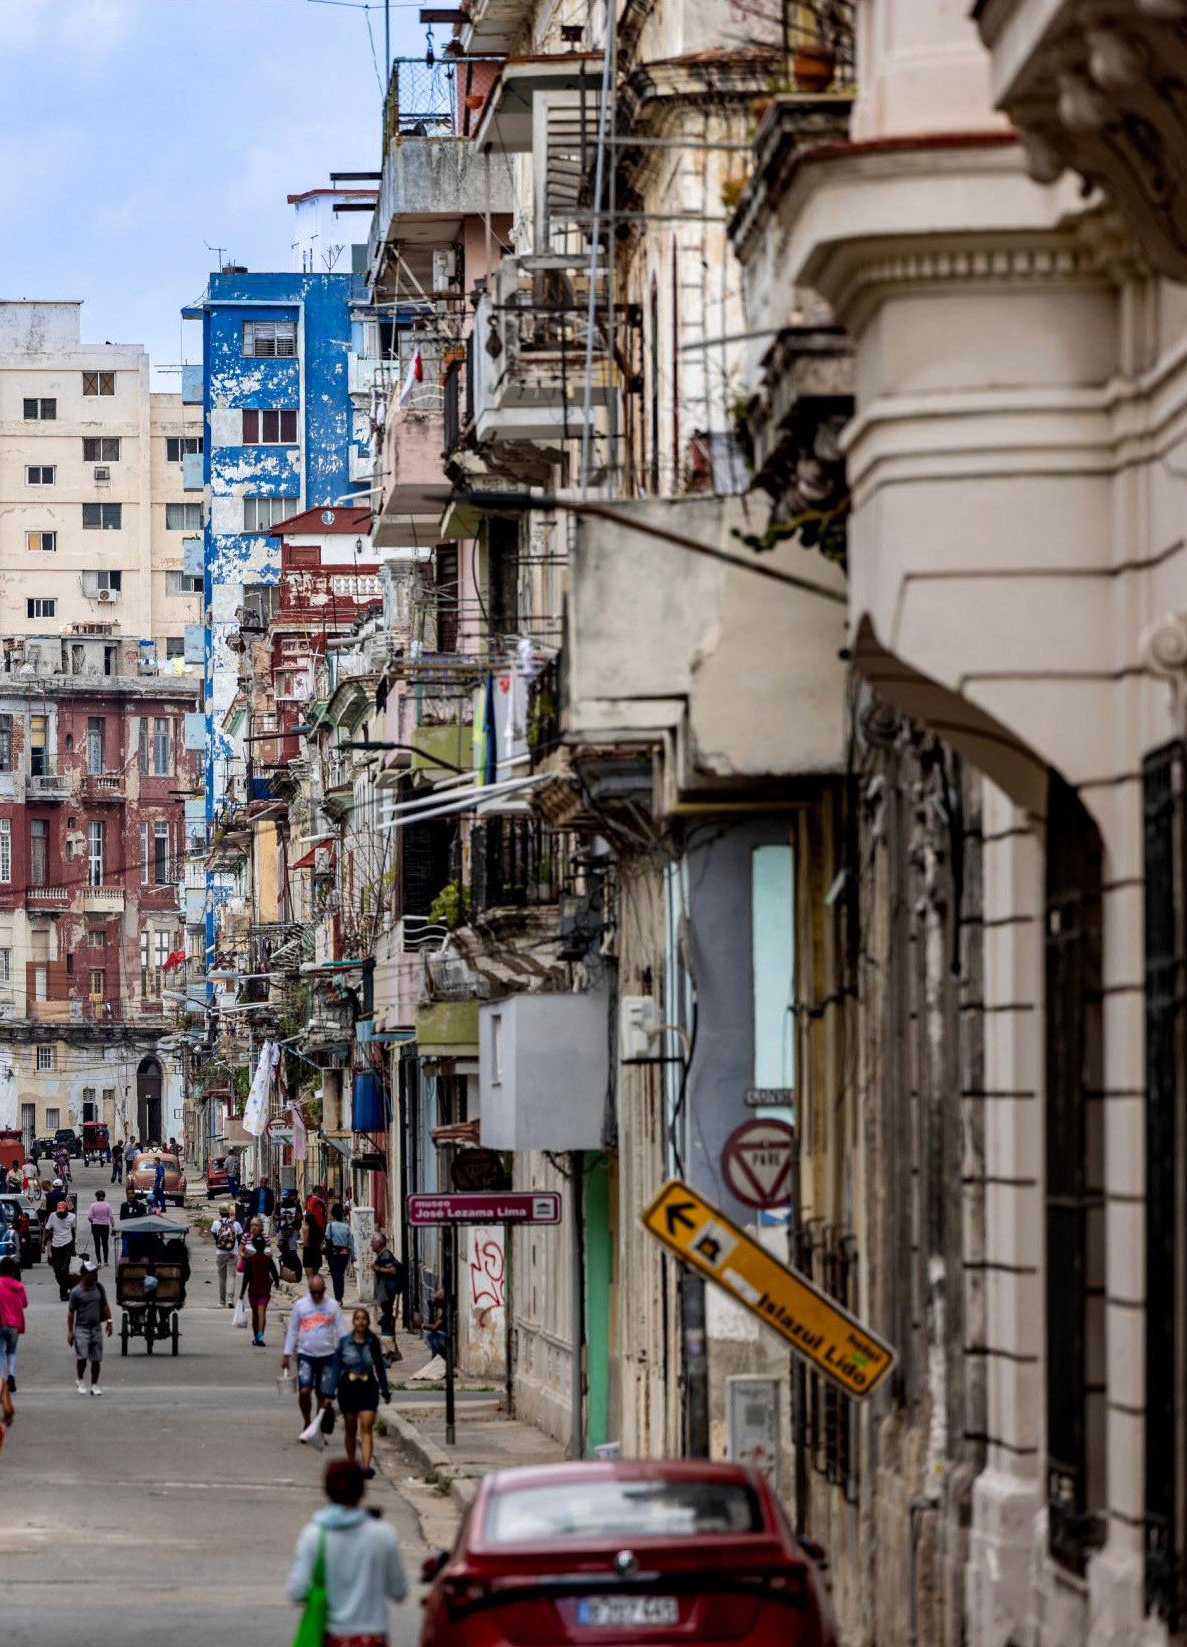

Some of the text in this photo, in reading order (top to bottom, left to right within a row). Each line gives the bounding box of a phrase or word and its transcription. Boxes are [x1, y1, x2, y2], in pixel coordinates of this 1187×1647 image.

[415, 1200, 450, 1208] museo
[415, 1207, 527, 1218] José Lezama Lima
[757, 1293, 867, 1386] Islazul Lido
